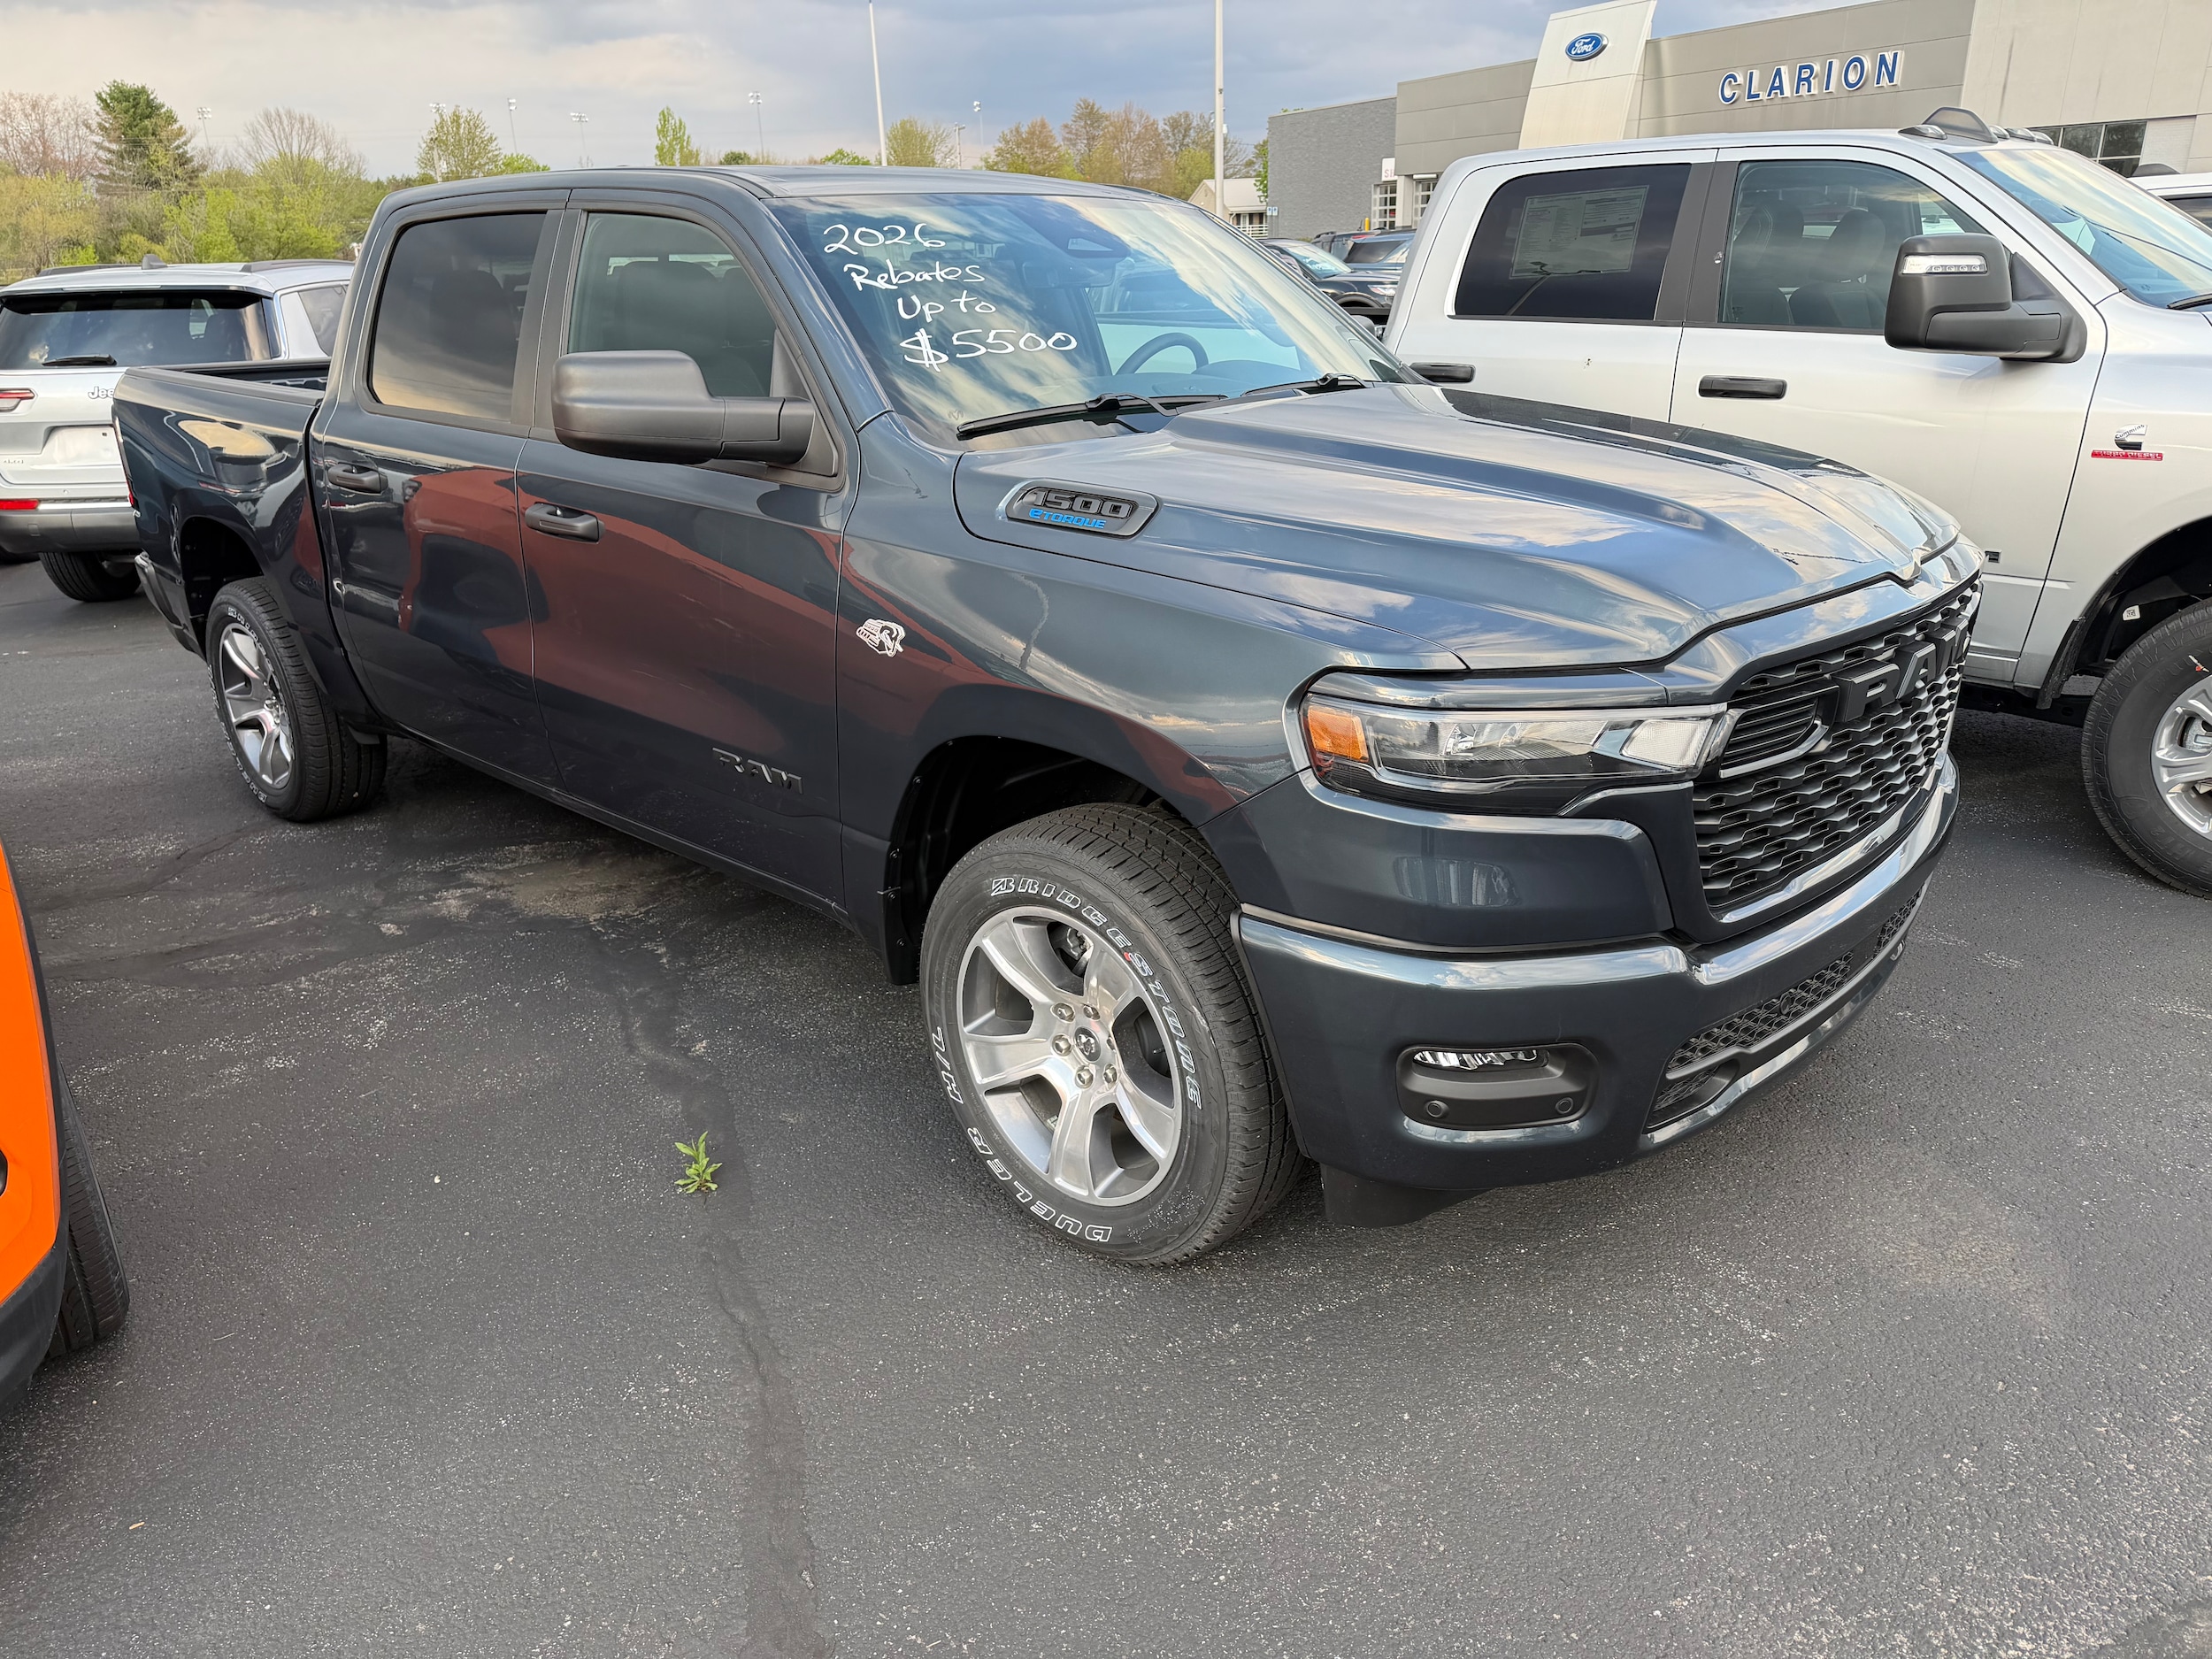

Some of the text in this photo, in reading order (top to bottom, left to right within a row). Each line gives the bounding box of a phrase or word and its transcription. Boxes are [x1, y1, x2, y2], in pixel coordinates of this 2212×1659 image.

[1571, 37, 1595, 55] Ford
[1718, 50, 1904, 104] CLARION
[823, 223, 946, 255] 2026
[843, 259, 986, 291] Rebates
[896, 290, 997, 322] Up to
[899, 327, 1079, 372] $5500
[88, 386, 115, 399] Jee
[2115, 424, 2145, 439] Cummins
[1032, 490, 1133, 518] 1500
[1831, 618, 1969, 722] RAM
[712, 747, 804, 795] RAM
[989, 876, 1203, 1110] BRIDGESTONE
[967, 1126, 1113, 1242] DUELER
